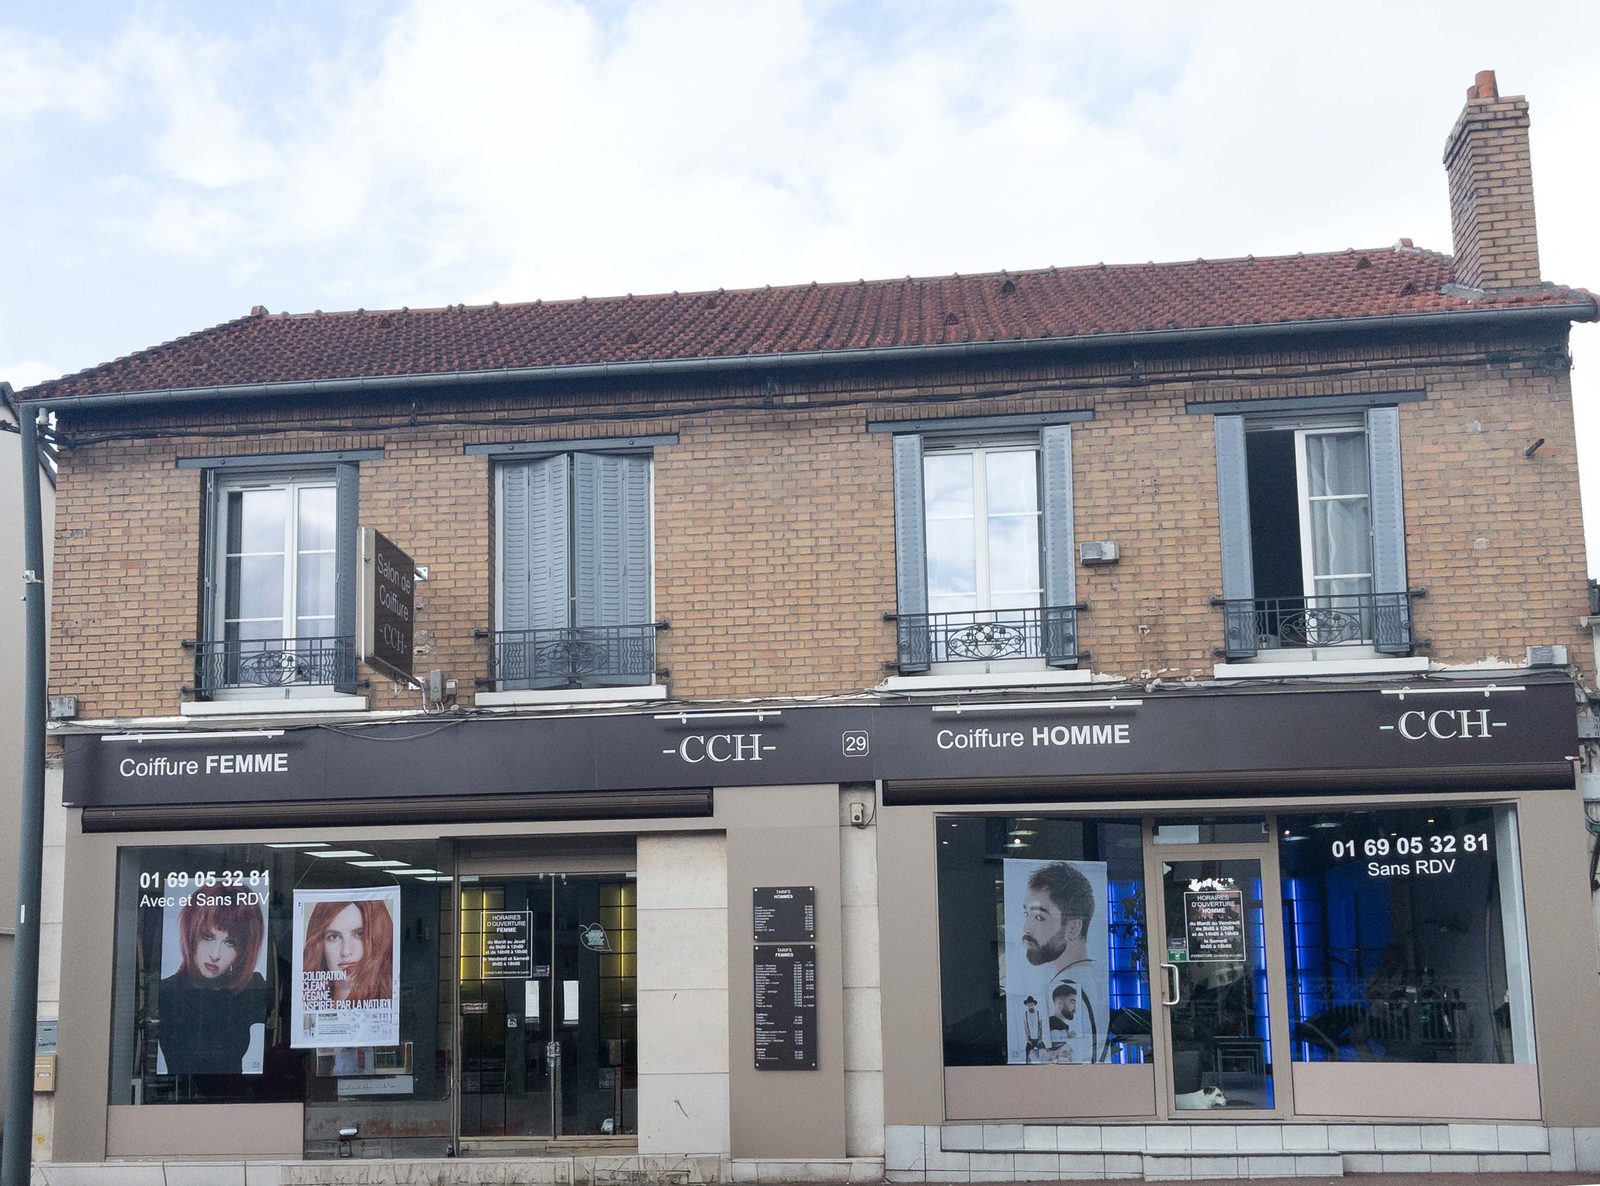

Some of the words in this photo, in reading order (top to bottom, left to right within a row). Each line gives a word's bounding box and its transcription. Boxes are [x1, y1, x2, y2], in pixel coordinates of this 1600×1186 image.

[377, 553, 399, 586] Salon
[402, 574, 410, 595] de
[379, 584, 408, 622] Coiffure
[846, 736, 866, 751] 29
[936, 728, 1024, 749] Coiffure
[1032, 724, 1130, 746] HOMME
[120, 758, 198, 776] Coiffure
[206, 753, 288, 774] FEMME
[1332, 840, 1355, 858] 01
[1364, 838, 1390, 856] 69
[1396, 836, 1422, 854] 05
[1430, 835, 1456, 853] 32
[1463, 834, 1488, 852] 81
[1368, 862, 1410, 876] Sans
[1416, 859, 1456, 874] RDV
[140, 872, 160, 888] 01
[167, 872, 188, 888] 69
[194, 871, 216, 887] 05
[222, 870, 244, 886] 32
[250, 870, 270, 886] 81
[140, 894, 174, 908] Avec
[178, 895, 192, 906] et
[196, 893, 232, 906] Sans
[236, 892, 270, 906] RDV
[302, 970, 346, 980] COLORATION
[336, 1000, 351, 1010] PAR
[352, 1000, 361, 1010] LA
